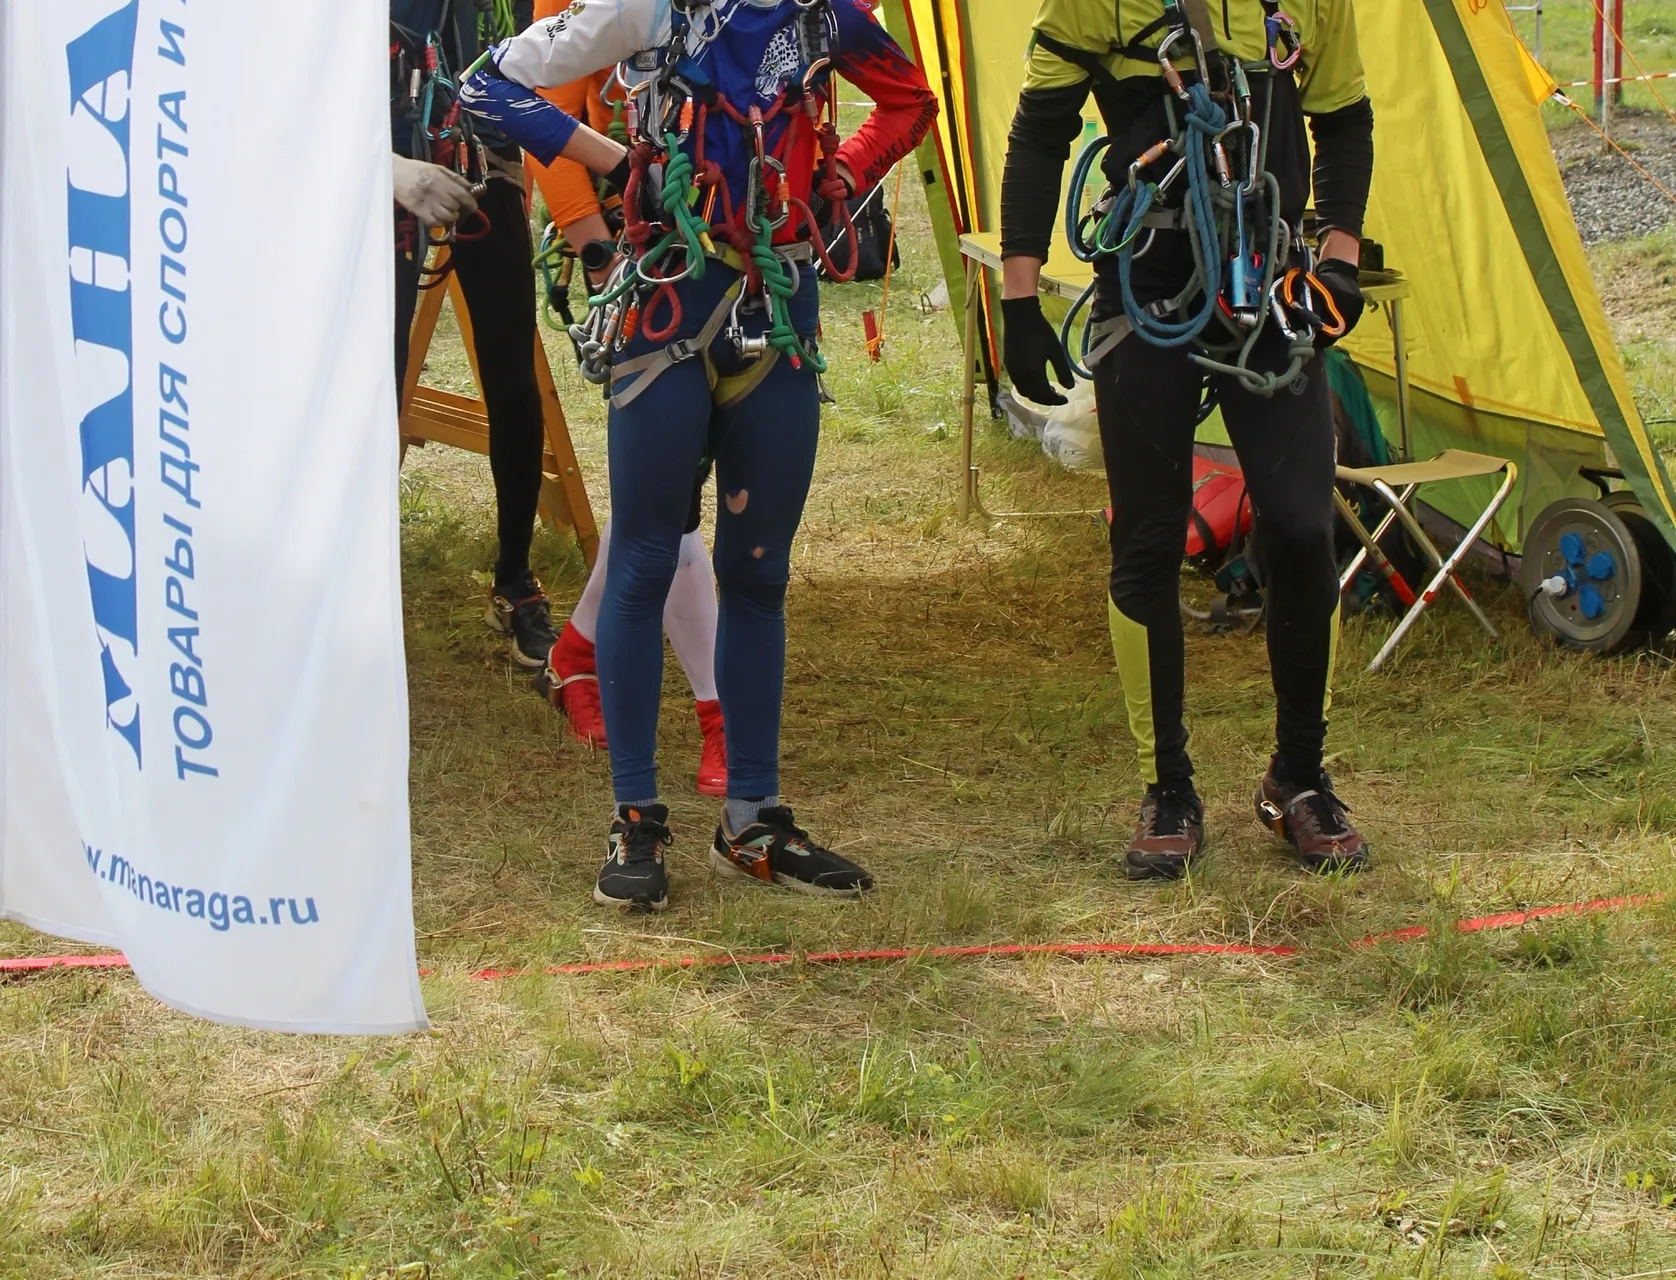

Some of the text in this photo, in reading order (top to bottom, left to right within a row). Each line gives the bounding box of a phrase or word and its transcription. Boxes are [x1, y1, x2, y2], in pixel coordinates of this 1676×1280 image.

[156, 17, 188, 66] И
[154, 90, 190, 345] СПОРТА
[157, 362, 201, 510] ДЛЯ
[161, 512, 219, 781] ТОВАРЫ
